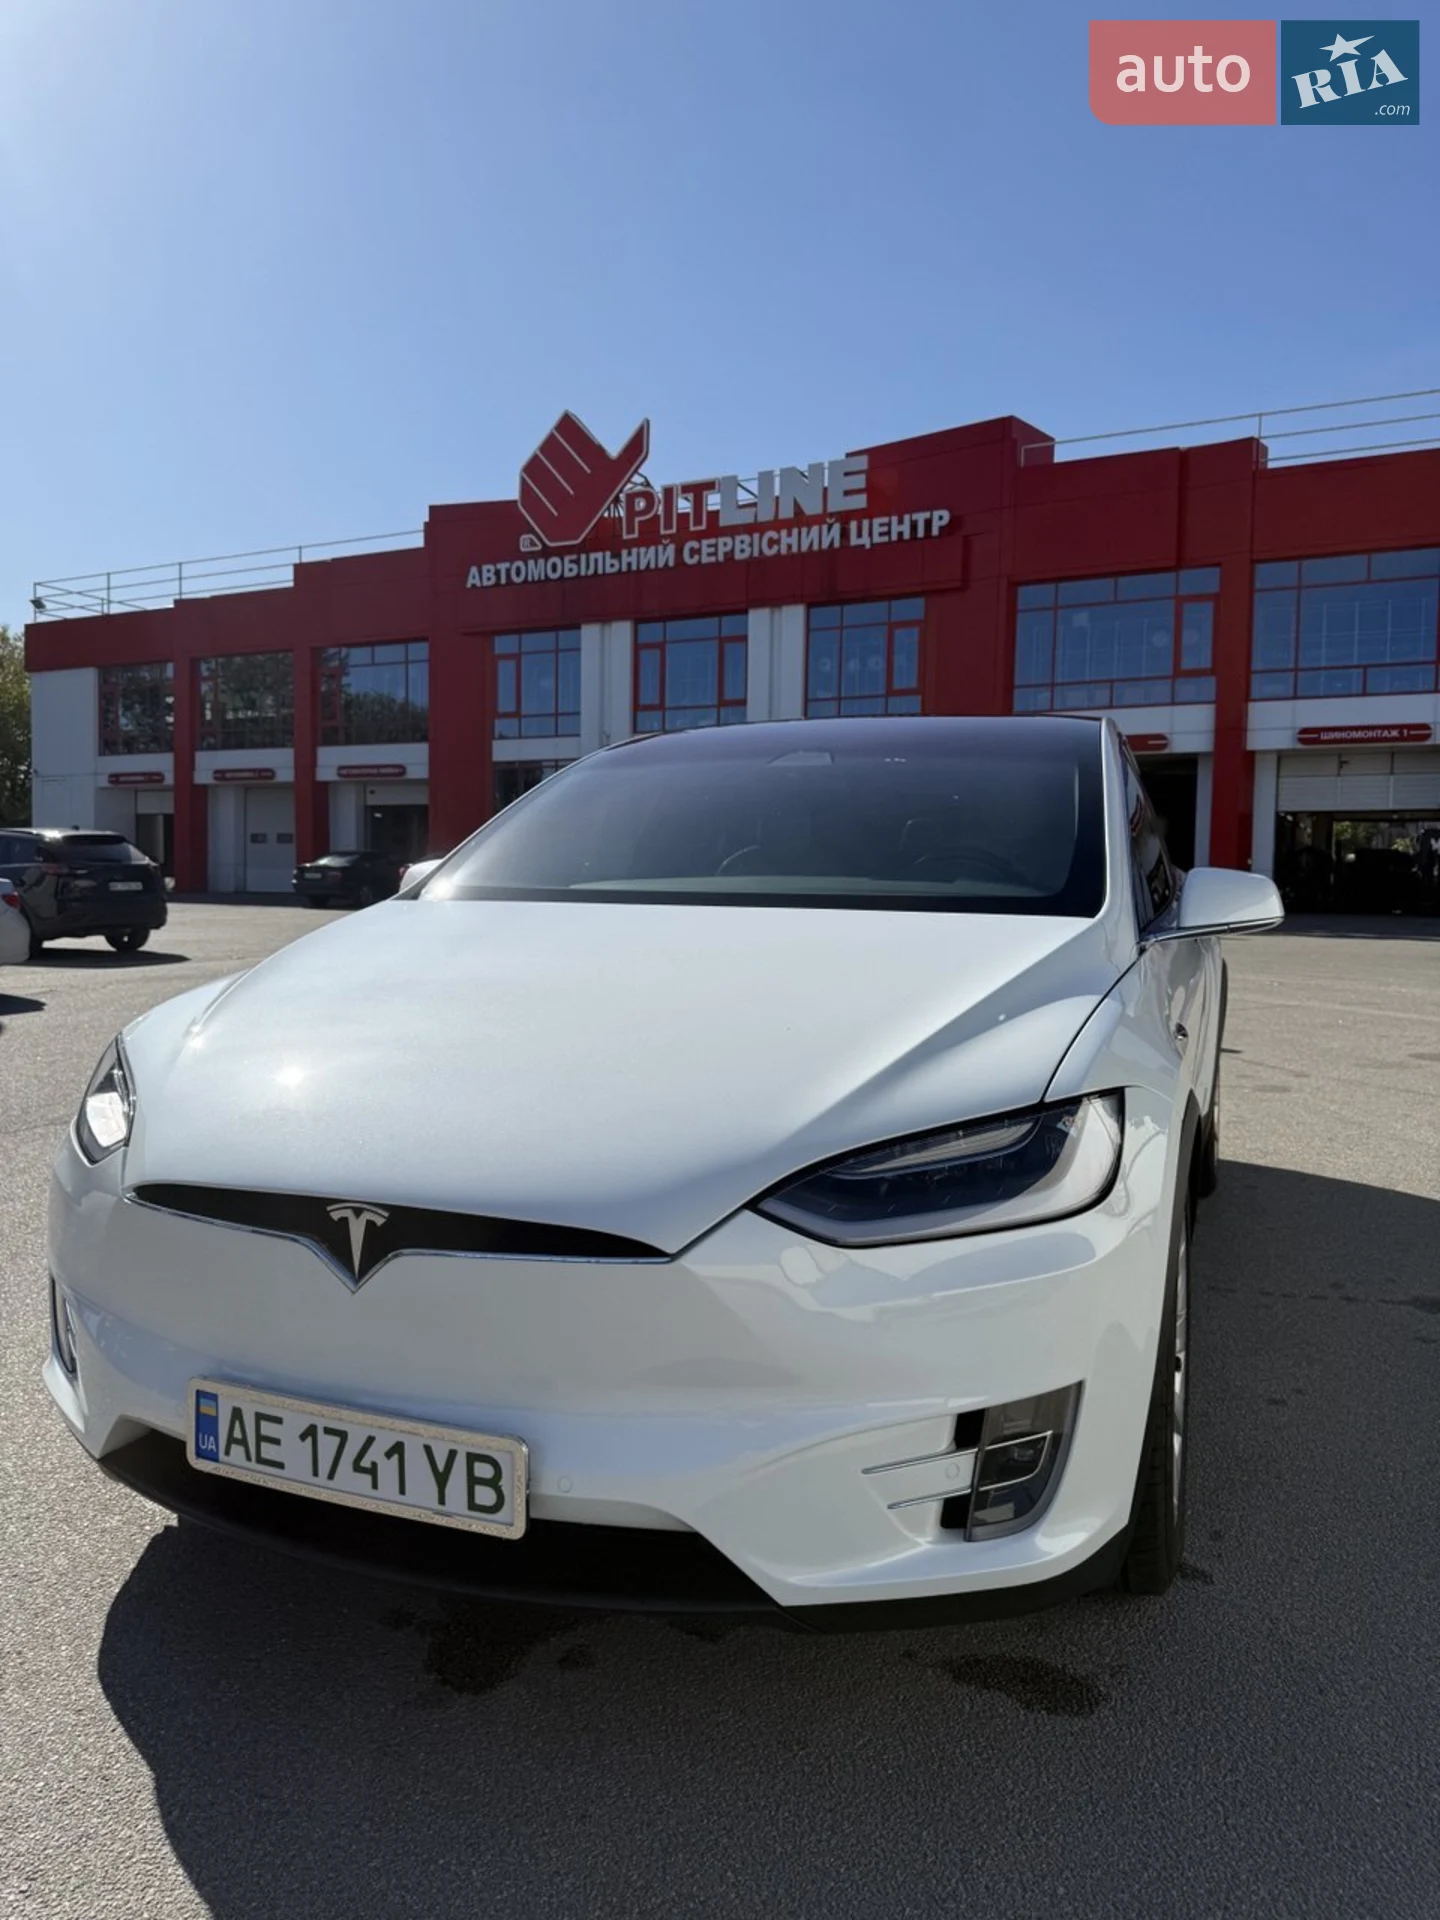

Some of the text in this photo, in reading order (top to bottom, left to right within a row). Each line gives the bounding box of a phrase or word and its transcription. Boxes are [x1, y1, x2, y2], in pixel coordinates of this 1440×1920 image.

[622, 455, 868, 539] PITLINE
[466, 509, 951, 588] АВТОМОБІЛЬНИЙ СЕРВІСНИЙ ЦЕНТР
[1320, 729, 1399, 740] ШИНОМОНТАЖ
[198, 1432, 217, 1452] UA
[223, 1405, 506, 1515] AE 1741 YB
